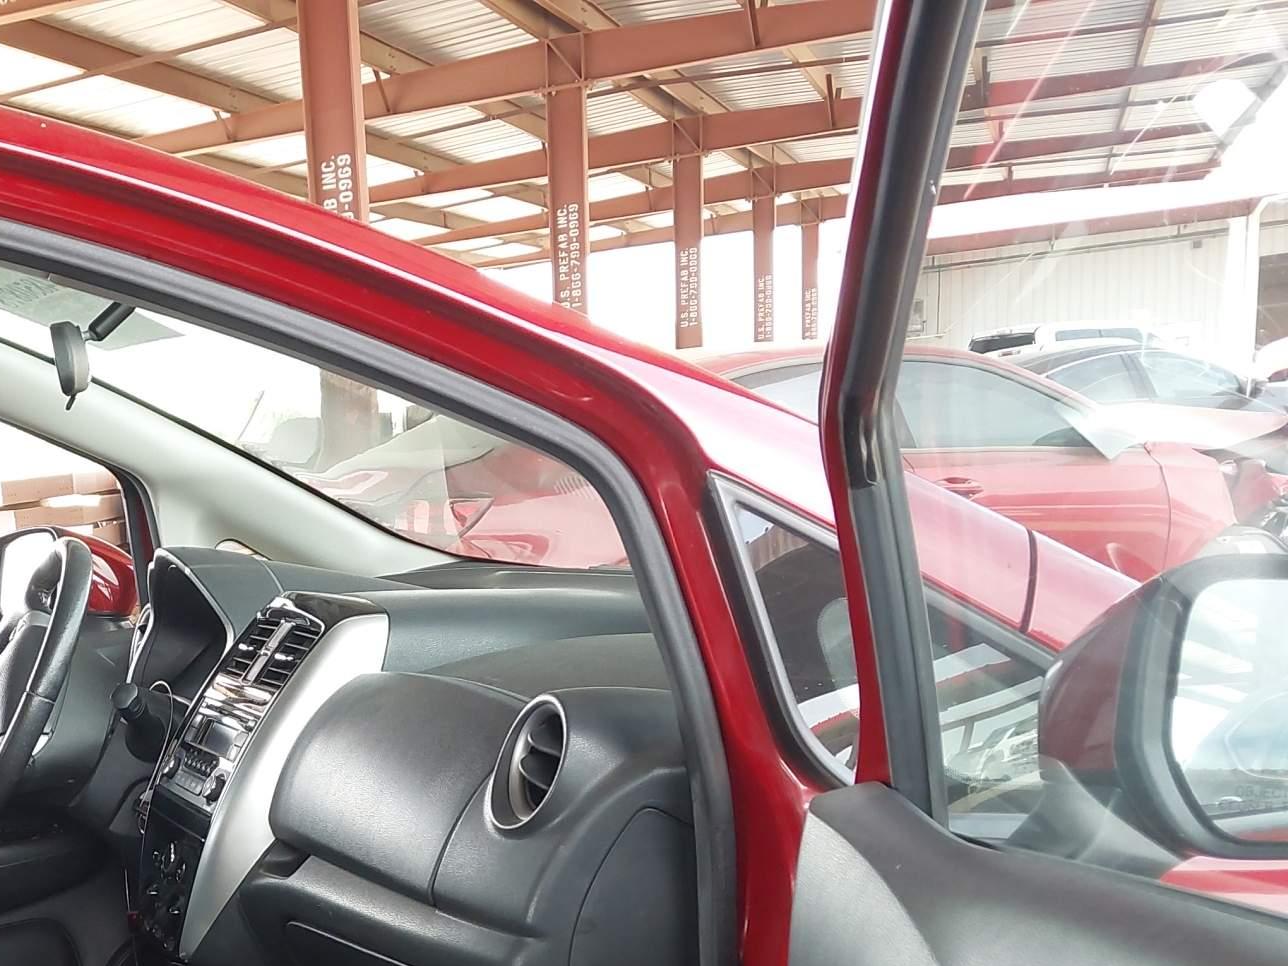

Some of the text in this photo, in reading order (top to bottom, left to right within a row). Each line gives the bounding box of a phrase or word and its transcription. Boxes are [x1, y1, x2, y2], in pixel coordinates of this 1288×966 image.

[321, 155, 337, 190] INC.
[557, 204, 568, 229] INC.
[558, 233, 569, 281] PREFAB
[568, 203, 582, 308] 1-866-799-0969
